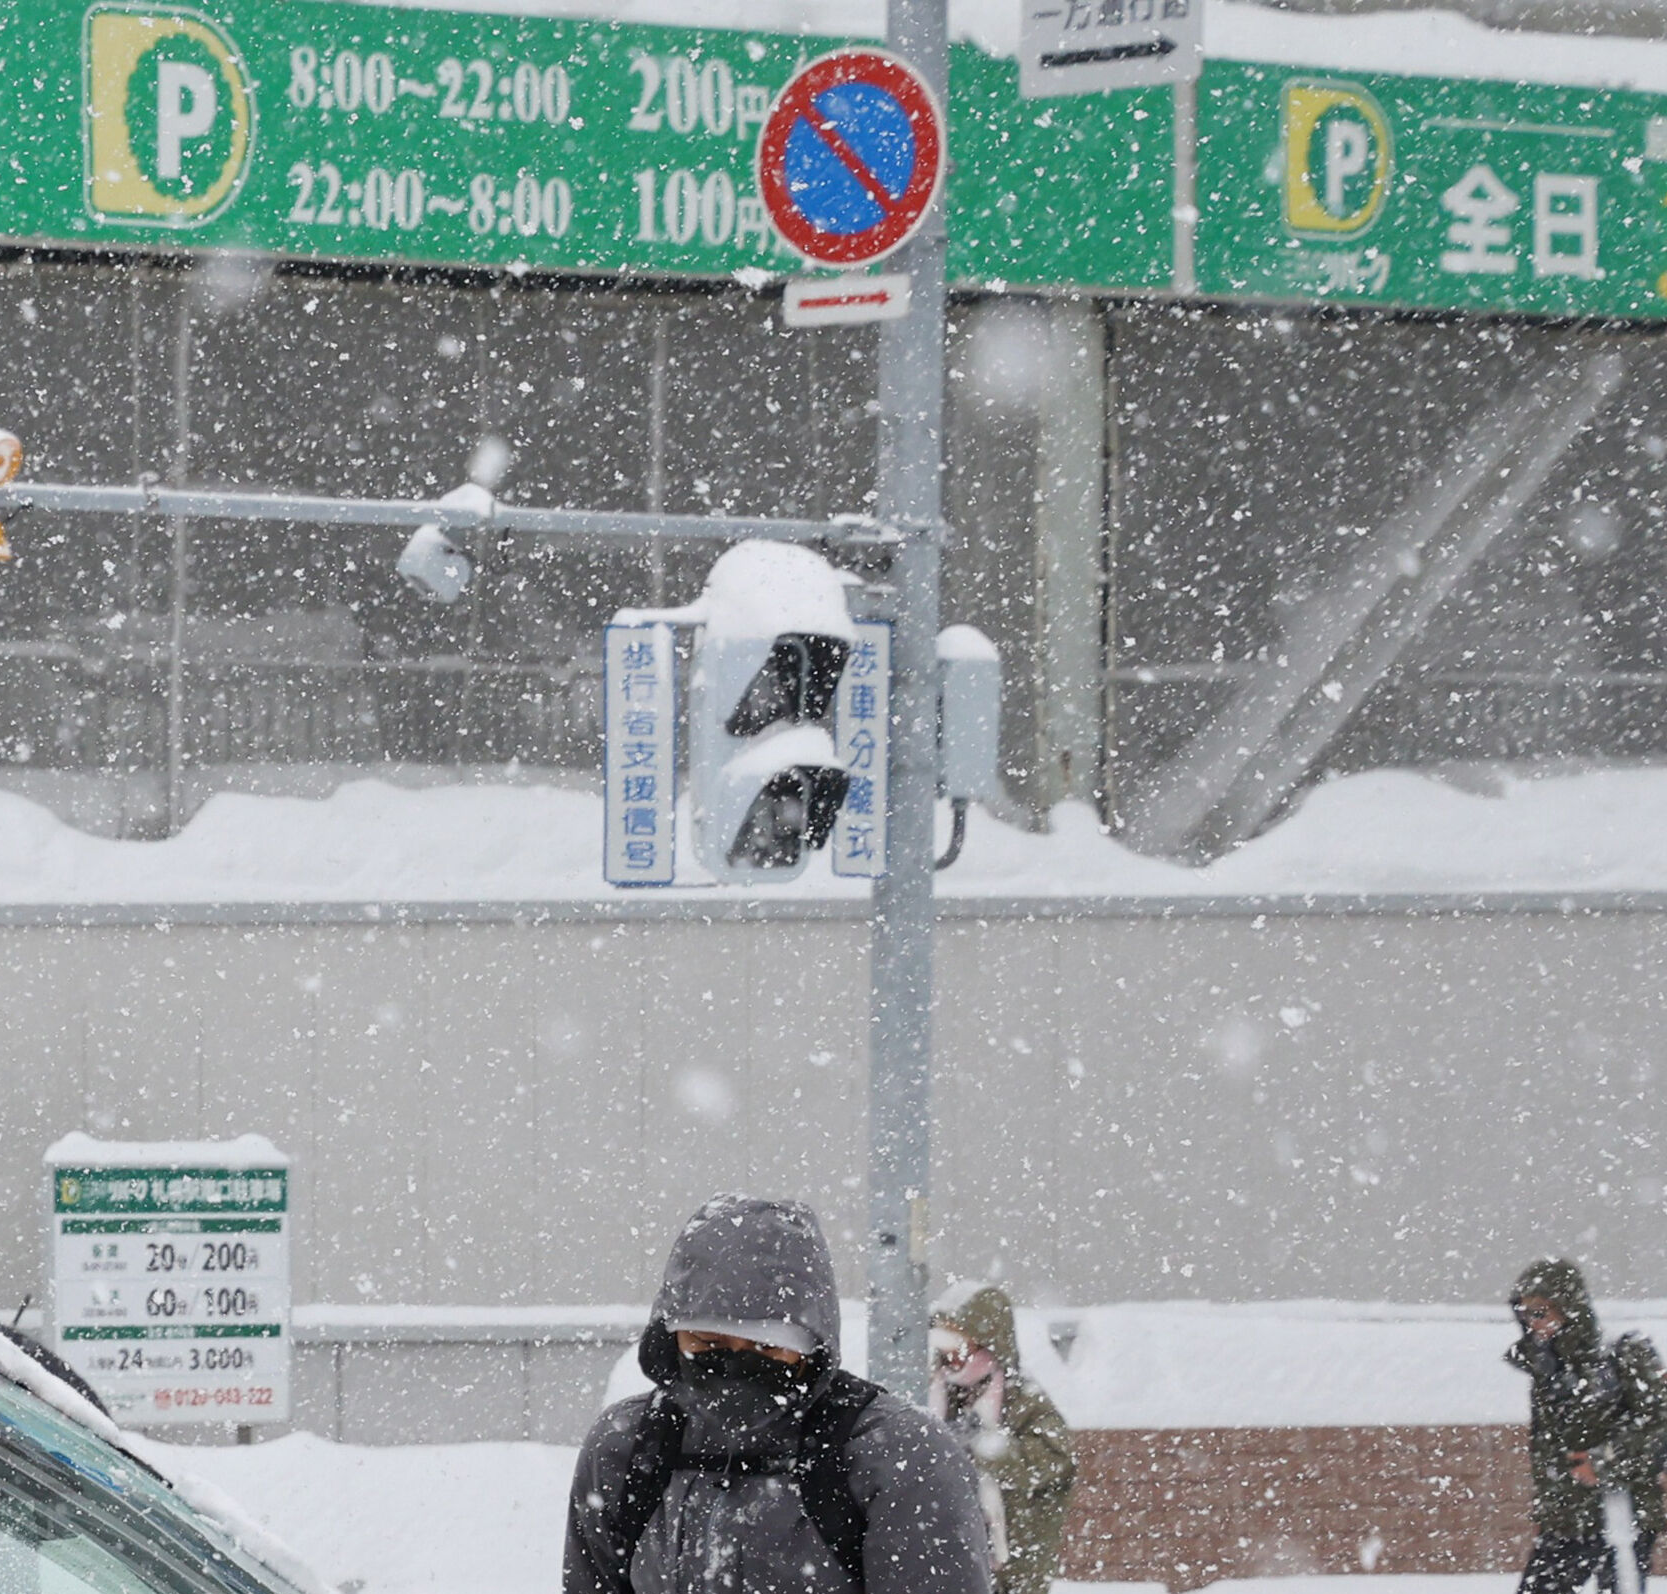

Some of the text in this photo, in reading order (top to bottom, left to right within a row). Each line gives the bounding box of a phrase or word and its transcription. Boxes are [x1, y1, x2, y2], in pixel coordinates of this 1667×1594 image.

[156, 60, 216, 179] P
[1326, 119, 1368, 217] P
[1440, 163, 1600, 279] 全日
[620, 640, 658, 870] 歩行者支援信号
